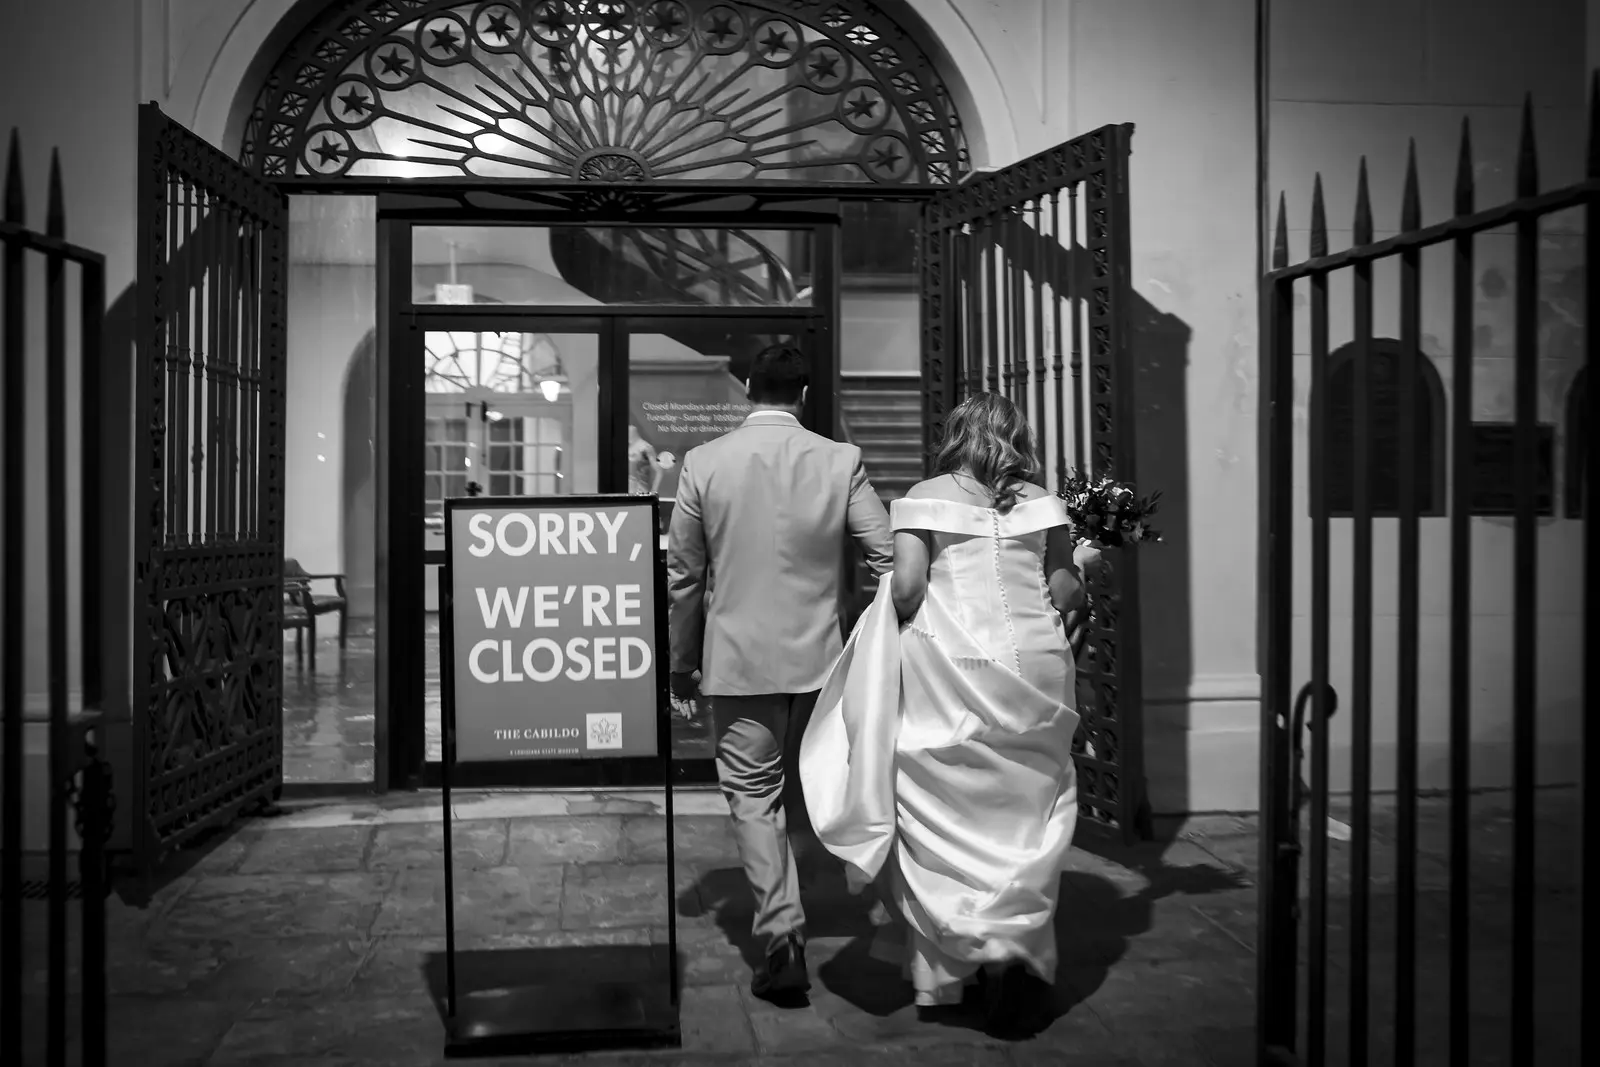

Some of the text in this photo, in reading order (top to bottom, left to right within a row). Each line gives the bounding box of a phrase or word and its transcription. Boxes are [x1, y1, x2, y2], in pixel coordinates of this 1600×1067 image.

[642, 402, 752, 412] Closed Mondays and all majo
[646, 413, 677, 423] Tuesday
[683, 413, 712, 423] Sunday
[670, 424, 688, 432] food
[468, 511, 642, 562] SORRY,
[475, 584, 641, 629] WE'RE
[468, 636, 652, 684] CLOSED
[494, 727, 580, 740] THE CABILDO
